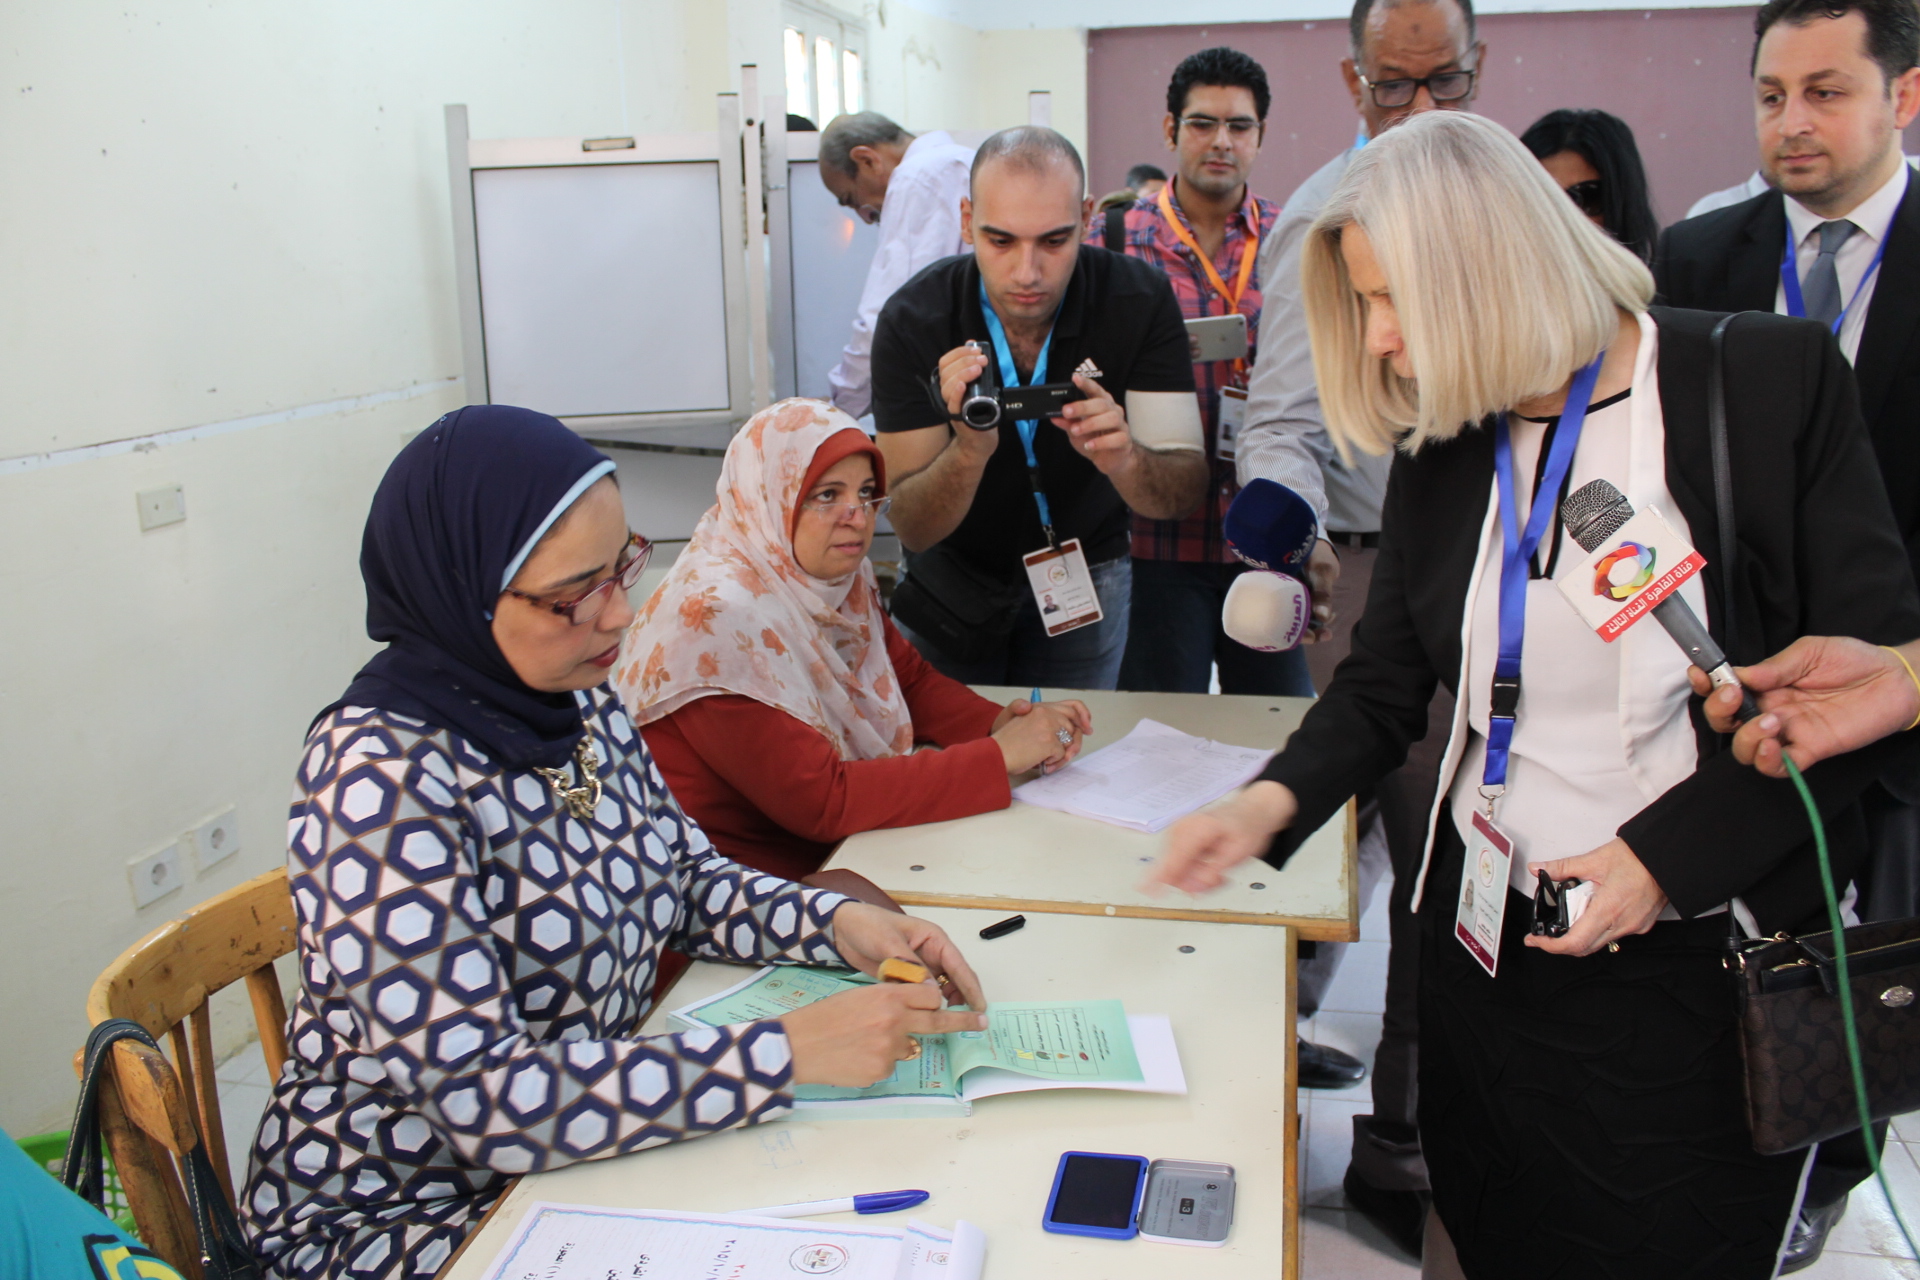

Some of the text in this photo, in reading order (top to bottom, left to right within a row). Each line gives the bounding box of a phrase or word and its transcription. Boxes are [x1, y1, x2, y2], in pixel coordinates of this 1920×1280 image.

[1005, 402, 1023, 410] HD
[1283, 594, 1302, 643] العربية
[1605, 560, 1693, 634] قناة القاهرة القناة الثالثة
